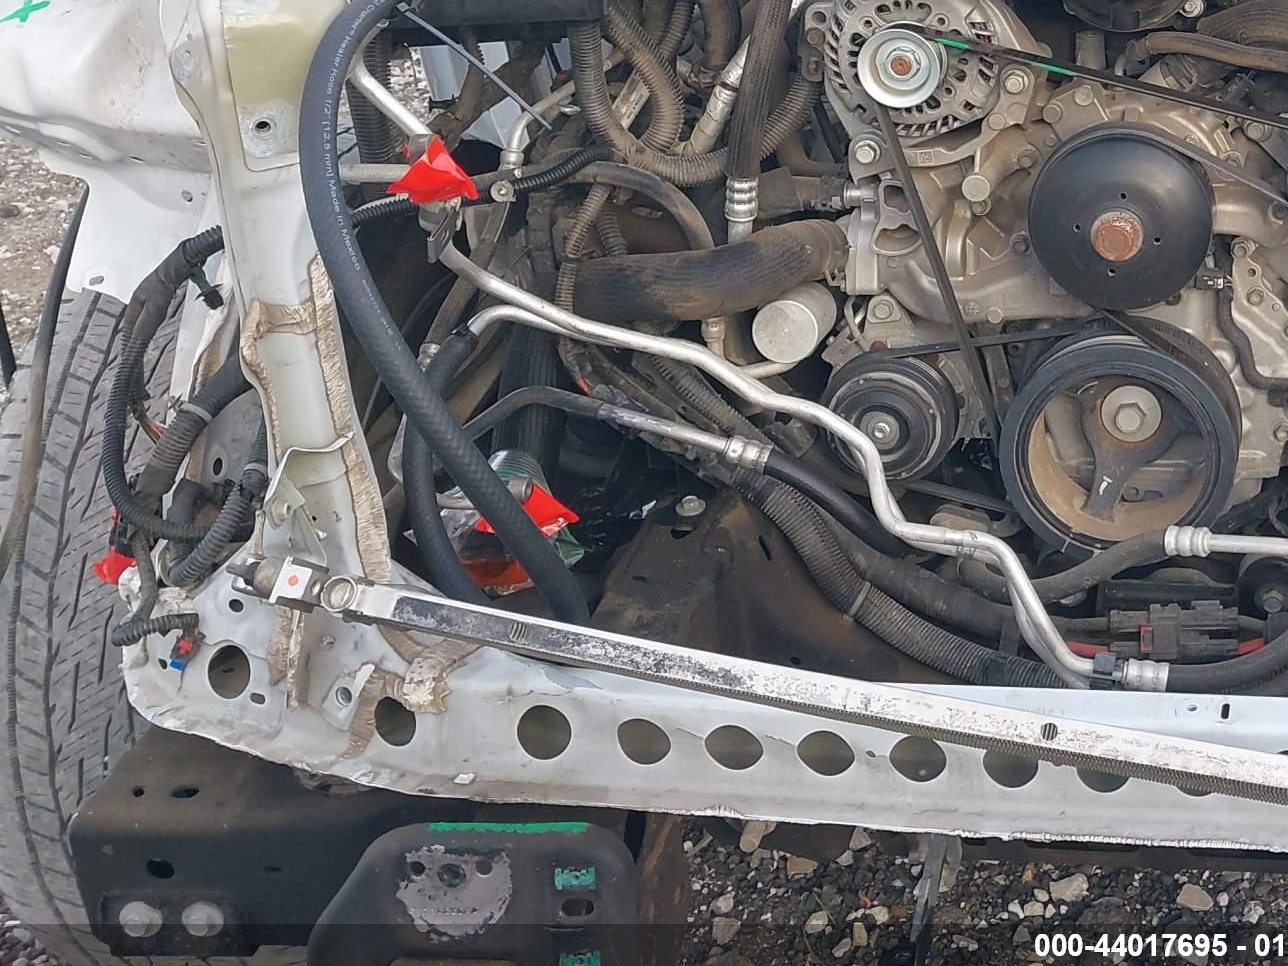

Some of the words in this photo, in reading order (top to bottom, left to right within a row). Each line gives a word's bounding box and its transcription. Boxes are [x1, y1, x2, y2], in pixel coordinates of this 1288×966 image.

[334, 35, 352, 67] Heater
[326, 178, 340, 212] Made
[340, 228, 361, 271] Mexico
